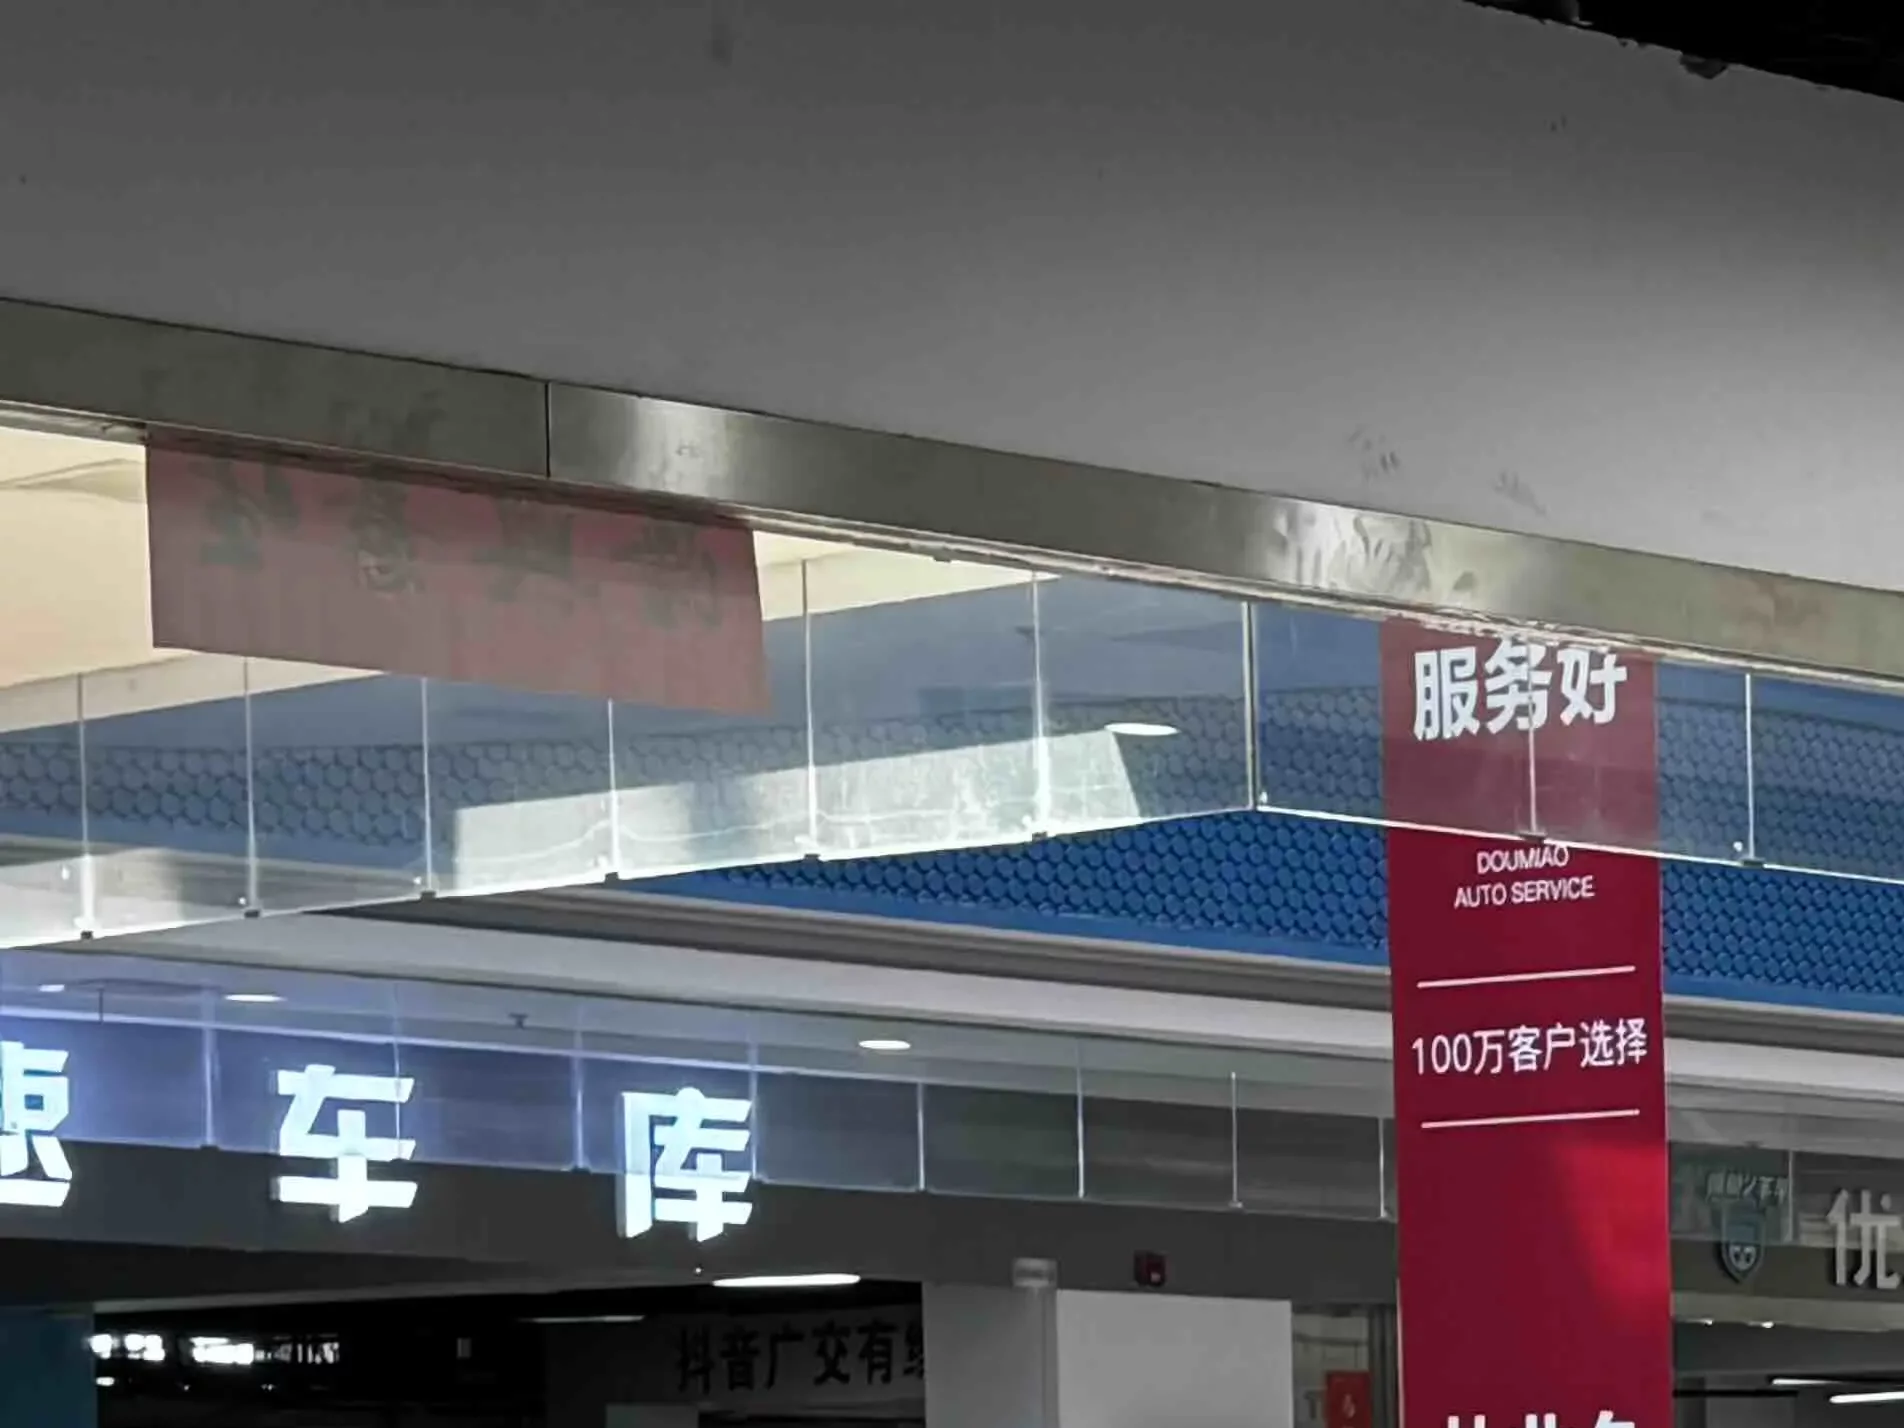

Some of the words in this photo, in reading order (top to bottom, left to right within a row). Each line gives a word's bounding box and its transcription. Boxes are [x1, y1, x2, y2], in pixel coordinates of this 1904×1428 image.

[1414, 637, 1628, 741] 服务好
[1477, 844, 1569, 875] DOUMIAO
[1454, 882, 1507, 910] AUTO
[1512, 875, 1596, 903] SERVICE
[1412, 1017, 1648, 1076] 100万客户选择
